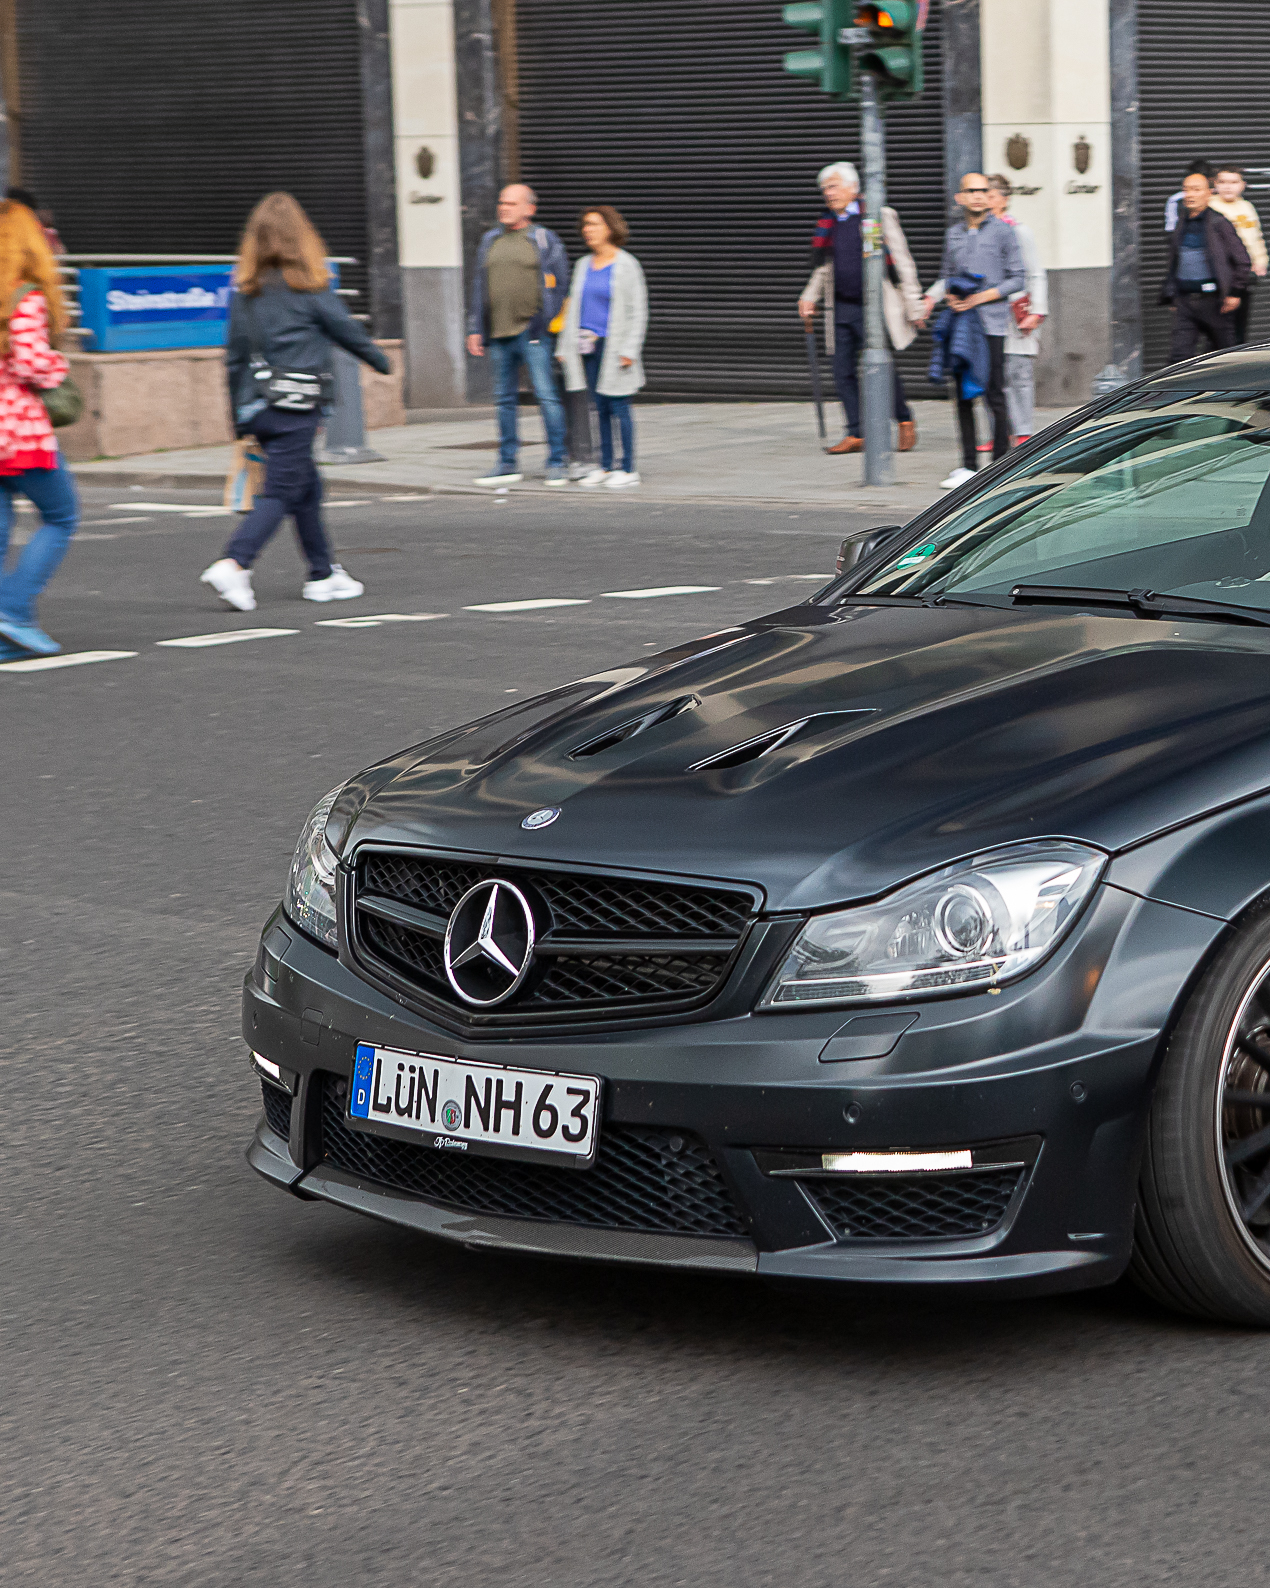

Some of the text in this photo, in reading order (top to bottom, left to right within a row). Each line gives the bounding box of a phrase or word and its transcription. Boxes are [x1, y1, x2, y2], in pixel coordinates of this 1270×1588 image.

[357, 1088, 366, 1106] D
[463, 1074, 523, 1136] NH
[532, 1083, 591, 1143] 63
